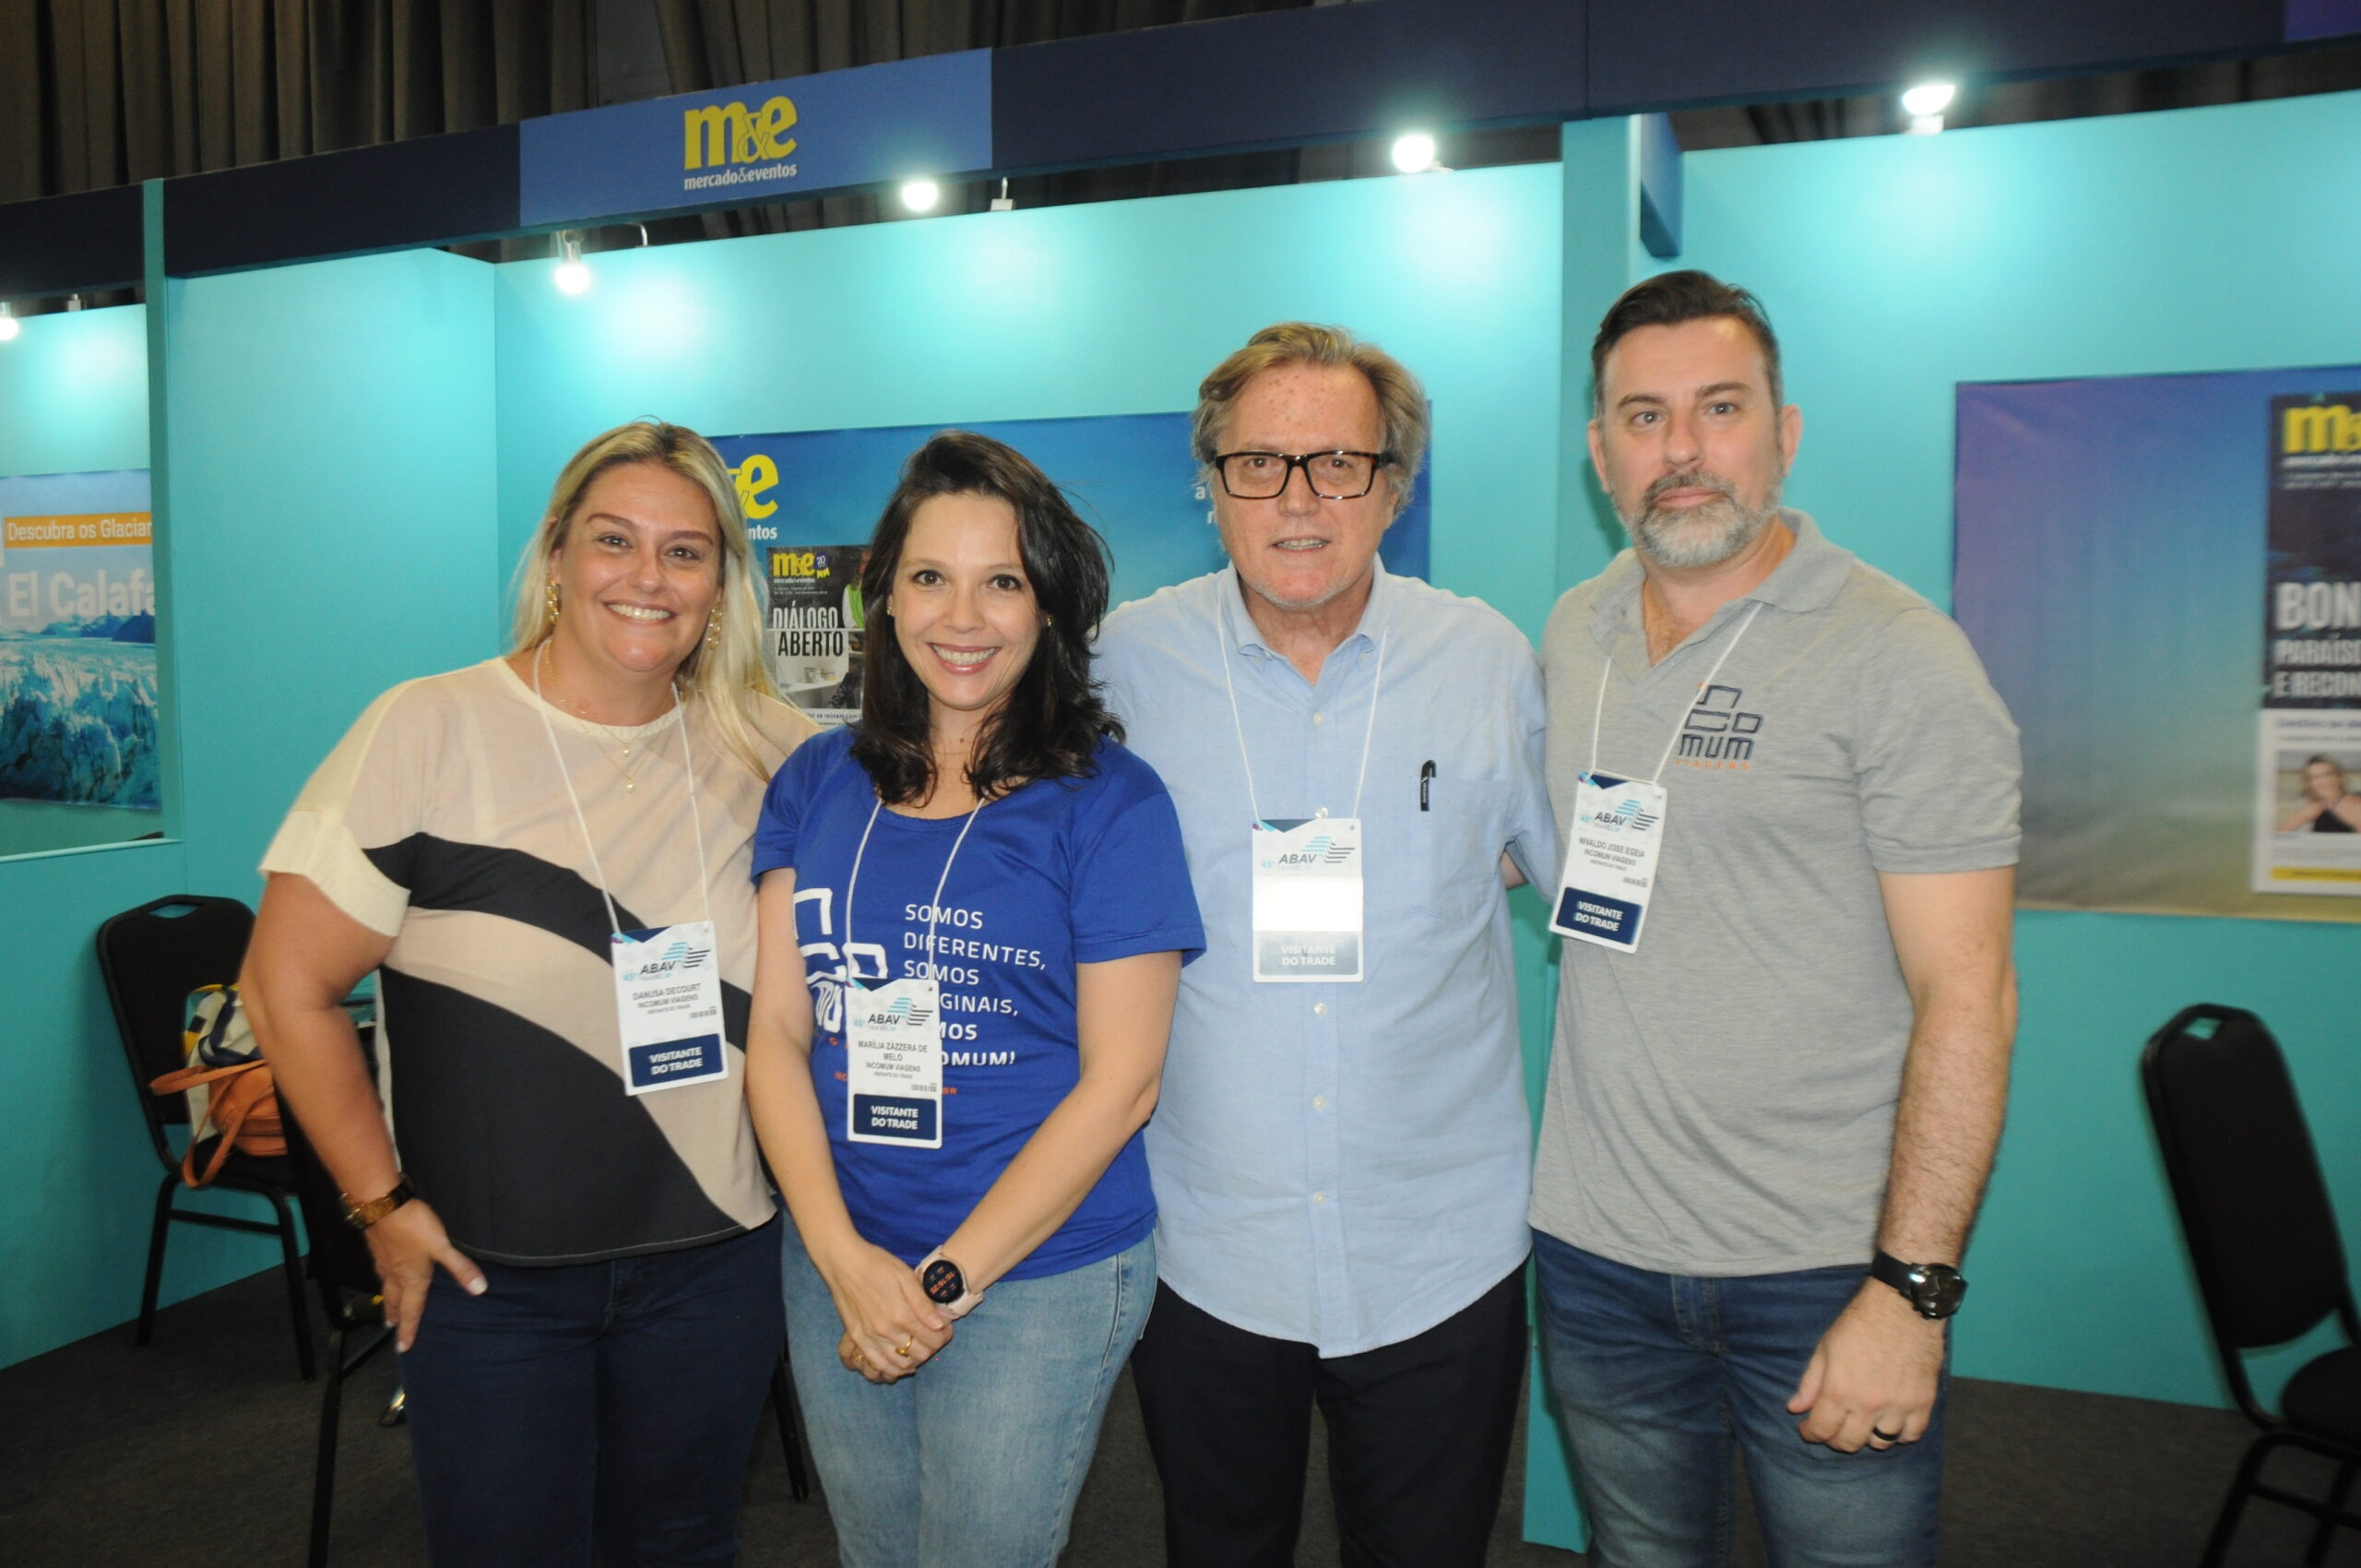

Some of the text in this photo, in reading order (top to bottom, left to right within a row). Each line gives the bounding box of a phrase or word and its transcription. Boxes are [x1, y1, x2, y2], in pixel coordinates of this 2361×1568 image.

[684, 95, 798, 171] m&e
[684, 163, 798, 191] mercado&eventos
[7, 519, 76, 541] Descubra
[79, 523, 97, 540] os
[8, 570, 39, 617] El
[773, 600, 838, 629] DIÁLOGO
[777, 631, 844, 657] ABERTO
[1594, 812, 1627, 826] ABAV
[1278, 853, 1317, 864] ABAV
[905, 904, 984, 930] SOMOS
[1577, 900, 1623, 921] VISITANTE
[1573, 911, 1619, 932] DO TRADE
[904, 932, 1046, 970] DIFERENTES,
[1283, 956, 1336, 966] DO TRADE
[640, 960, 676, 975] ABAV
[904, 959, 979, 986] SOMOS
[940, 992, 1018, 1016] GINAIS,
[868, 1013, 901, 1025] ABAV
[648, 1046, 703, 1064] VISITANTE
[919, 1044, 929, 1052] DE
[650, 1057, 704, 1076] DO TRADE
[871, 1105, 919, 1118] VISITANTE
[872, 1117, 919, 1130] DO TRADE
